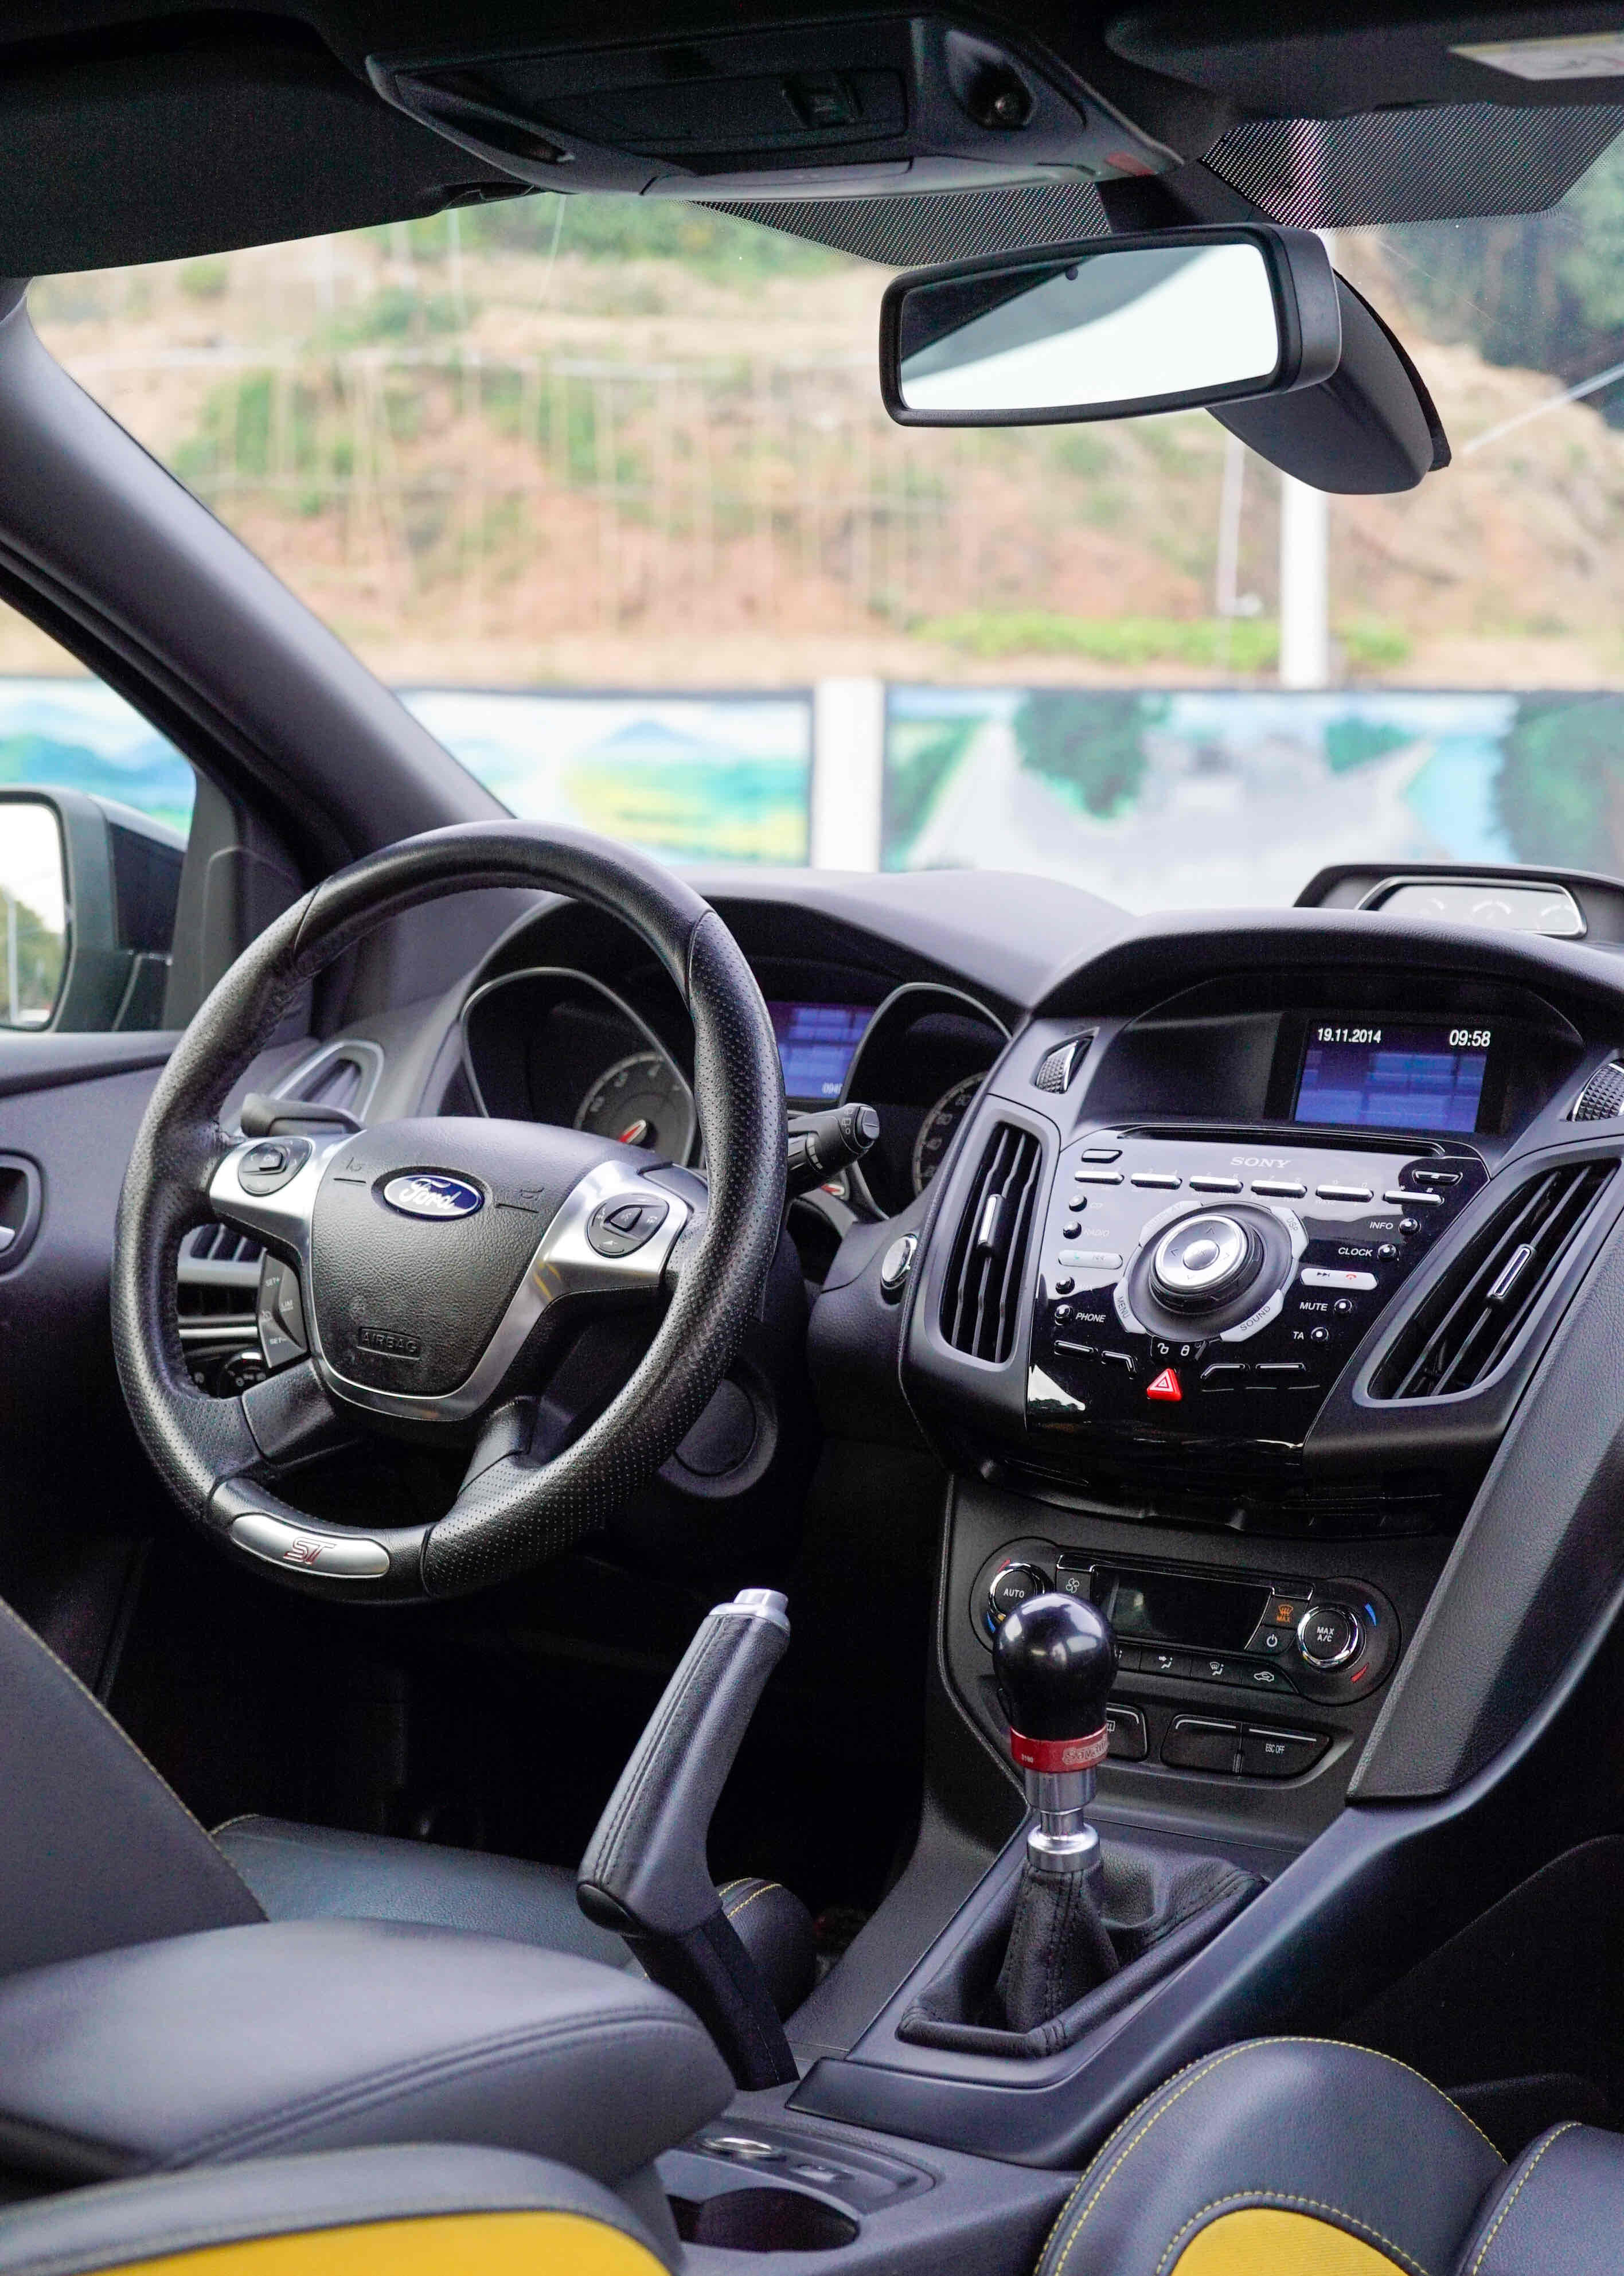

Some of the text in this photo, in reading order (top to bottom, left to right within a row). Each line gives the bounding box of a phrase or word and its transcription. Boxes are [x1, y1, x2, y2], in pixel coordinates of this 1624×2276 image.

[1318, 1028, 1381, 1043] 19.11.2014
[1449, 1029, 1491, 1047] 09:58
[1230, 1156, 1291, 1168] SONY
[399, 1178, 462, 1209] Ford
[1369, 1221, 1393, 1230] INFO
[1083, 1229, 1110, 1239] RADIO
[1338, 1247, 1373, 1256] CLOCK
[1118, 1296, 1130, 1319] MENU
[1299, 1302, 1328, 1311] MUTE
[1075, 1312, 1106, 1322] PHONE
[1240, 1305, 1271, 1331] SOUND
[1294, 1331, 1304, 1340] TA
[362, 1332, 418, 1352] AIRBAG
[283, 1536, 338, 1565] ST
[1003, 1587, 1025, 1599] AUTO
[1317, 1626, 1334, 1635] MAX
[1317, 1634, 1333, 1642] A/C
[1265, 1743, 1285, 1754] ESC OFF
